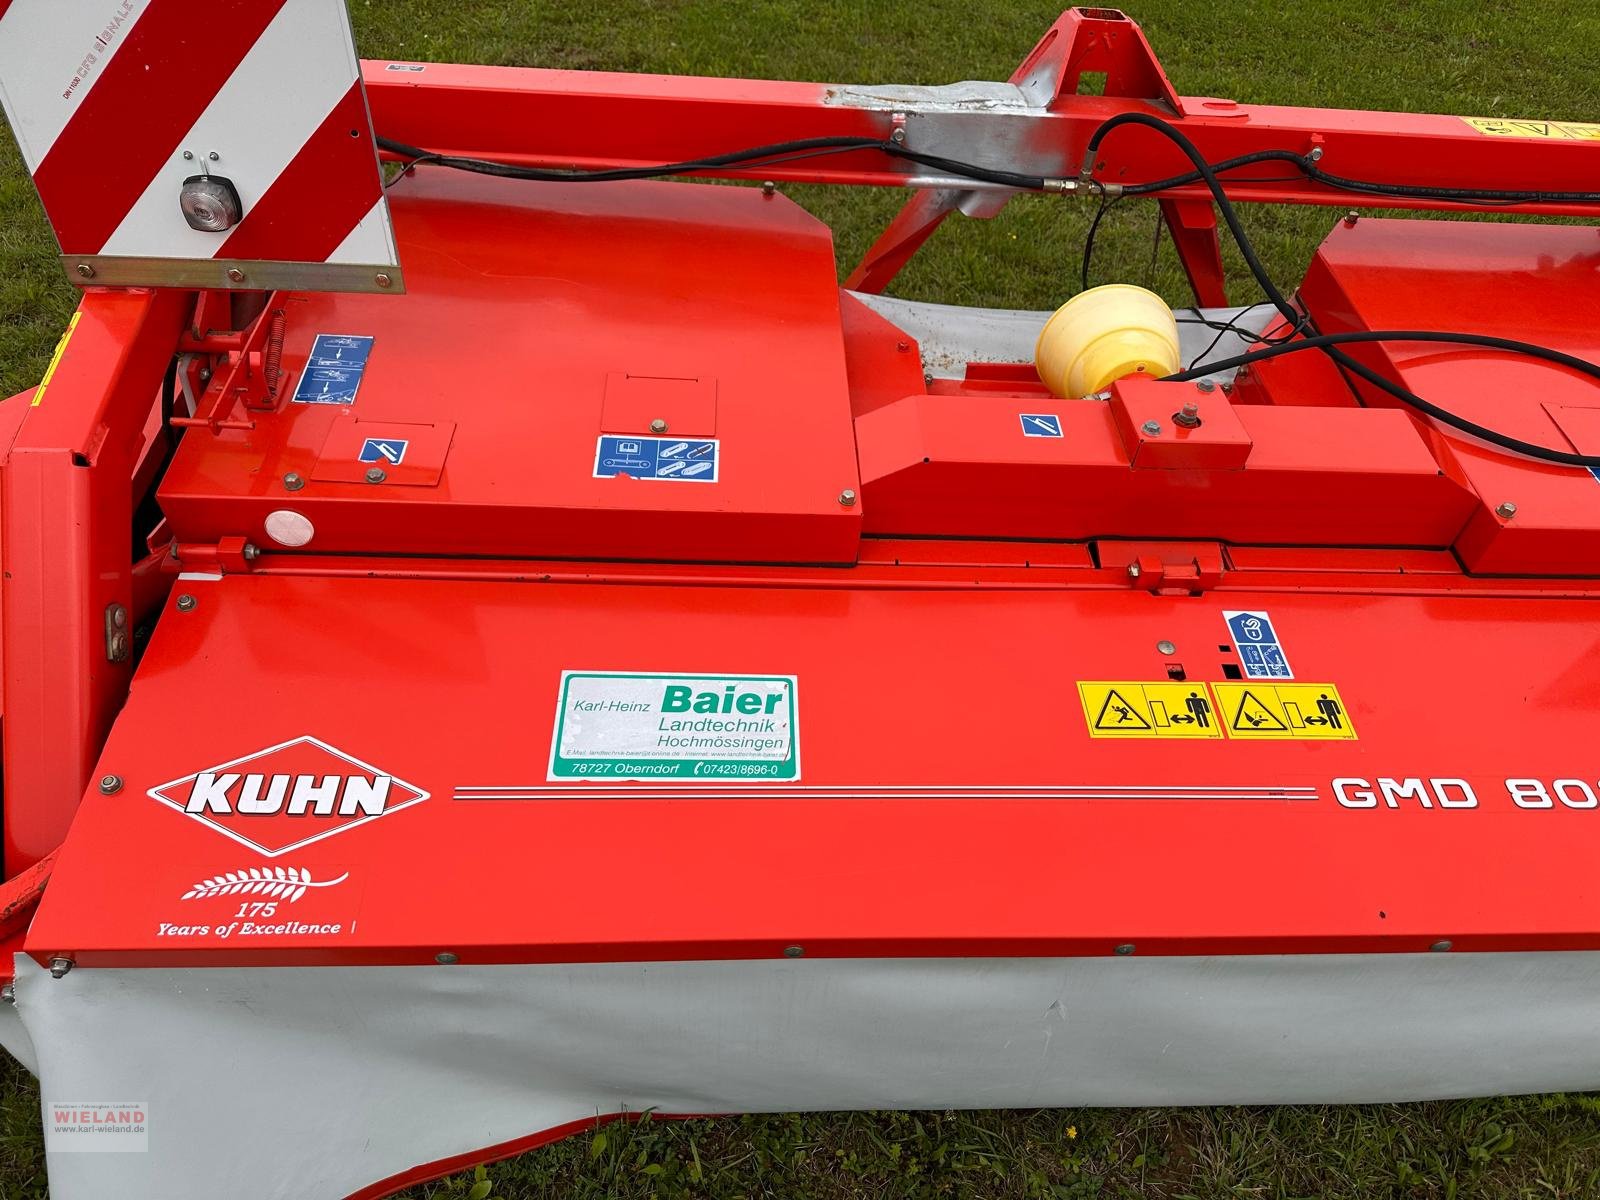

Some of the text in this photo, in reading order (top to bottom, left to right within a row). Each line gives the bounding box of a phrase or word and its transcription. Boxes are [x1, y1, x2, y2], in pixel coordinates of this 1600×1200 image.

[573, 685, 783, 715] Karl-Heinz Baier
[658, 718, 775, 732] Landtechnik
[657, 735, 783, 751] Hochmössingen
[571, 763, 778, 775] 78727 Oberndorf 07423/8696-0
[184, 773, 393, 816] KUHN
[1331, 777, 1600, 809] GMD 80
[234, 901, 278, 918] 175
[157, 921, 341, 938] Years of Excellence
